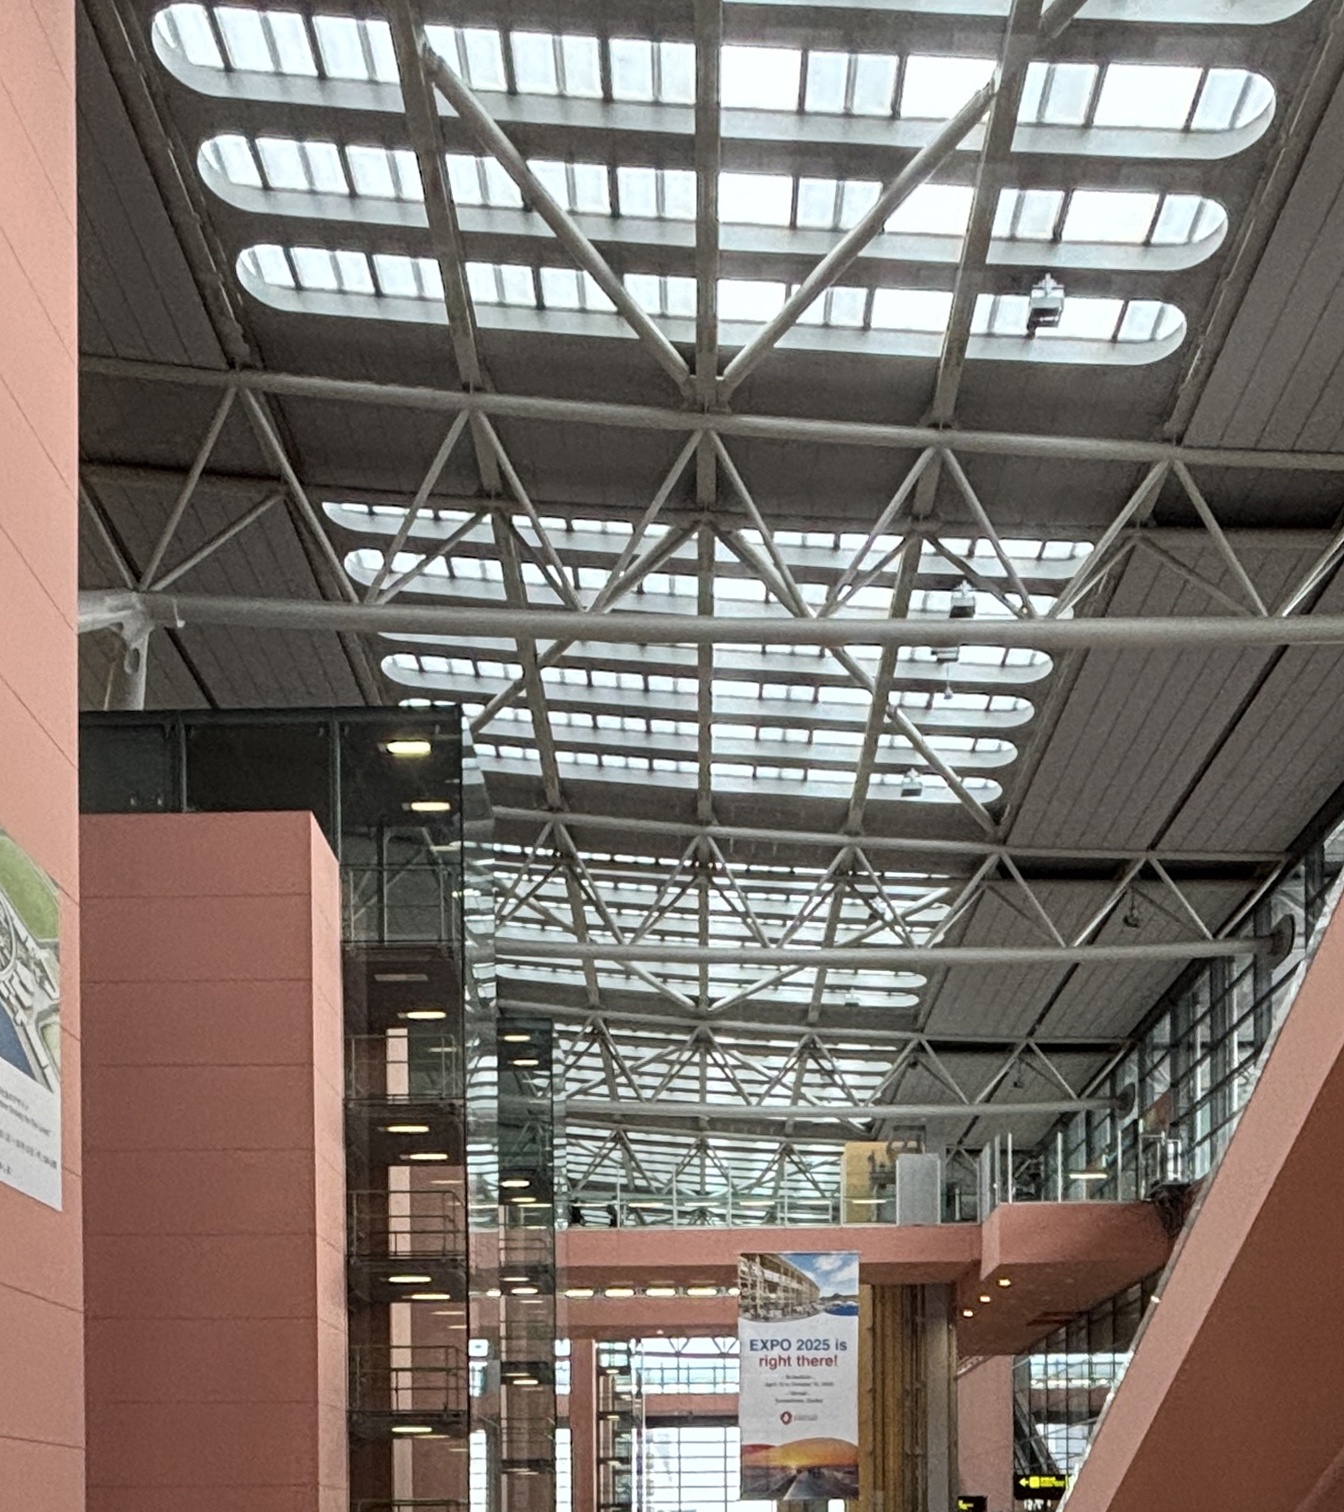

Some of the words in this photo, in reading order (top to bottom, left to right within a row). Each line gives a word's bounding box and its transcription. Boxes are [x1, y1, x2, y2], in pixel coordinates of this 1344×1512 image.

[749, 1338, 792, 1351] EXPO
[796, 1338, 830, 1351] 2025
[835, 1338, 848, 1351] is
[759, 1355, 792, 1370] right
[796, 1355, 838, 1367] there!
